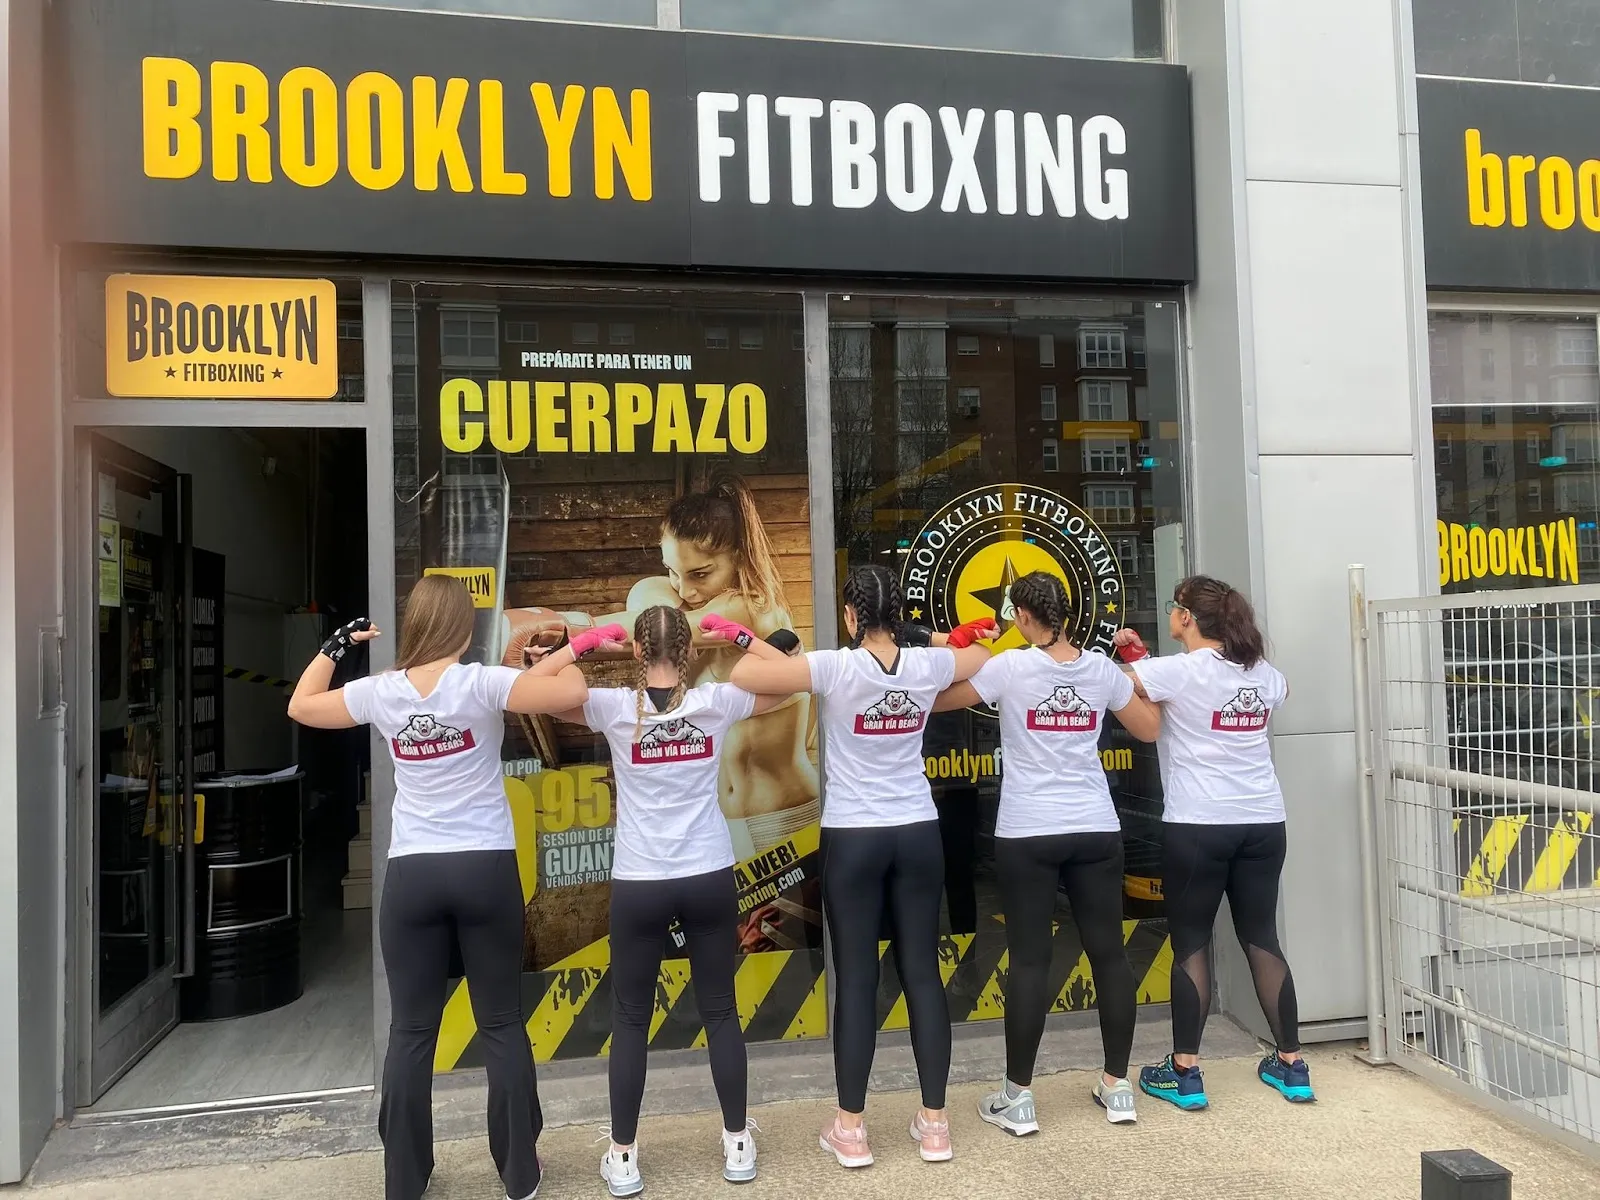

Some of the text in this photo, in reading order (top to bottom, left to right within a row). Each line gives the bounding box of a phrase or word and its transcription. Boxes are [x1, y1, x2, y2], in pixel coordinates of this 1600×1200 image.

[142, 56, 1130, 221] BROOKLYN FITBOXING
[126, 290, 318, 365] BROOKLYN
[521, 350, 692, 370] PREPÁRATE PARA TENER UN
[183, 362, 265, 383] FITBOXING
[439, 378, 768, 455] CUERPAZO
[907, 492, 1120, 602] BROOKLYN FITBOXING
[1436, 516, 1579, 587] BROOKLYN
[885, 717, 897, 729] VÍA
[1056, 714, 1068, 726] VÍA
[400, 737, 465, 756] GRAN VÍA BEARS
[641, 743, 706, 758] GRAN VÍA BEARS
[517, 759, 542, 775] POR
[543, 828, 617, 847] SESIÓN DE P
[747, 840, 799, 881] WEB!
[545, 873, 583, 889] VENDAS
